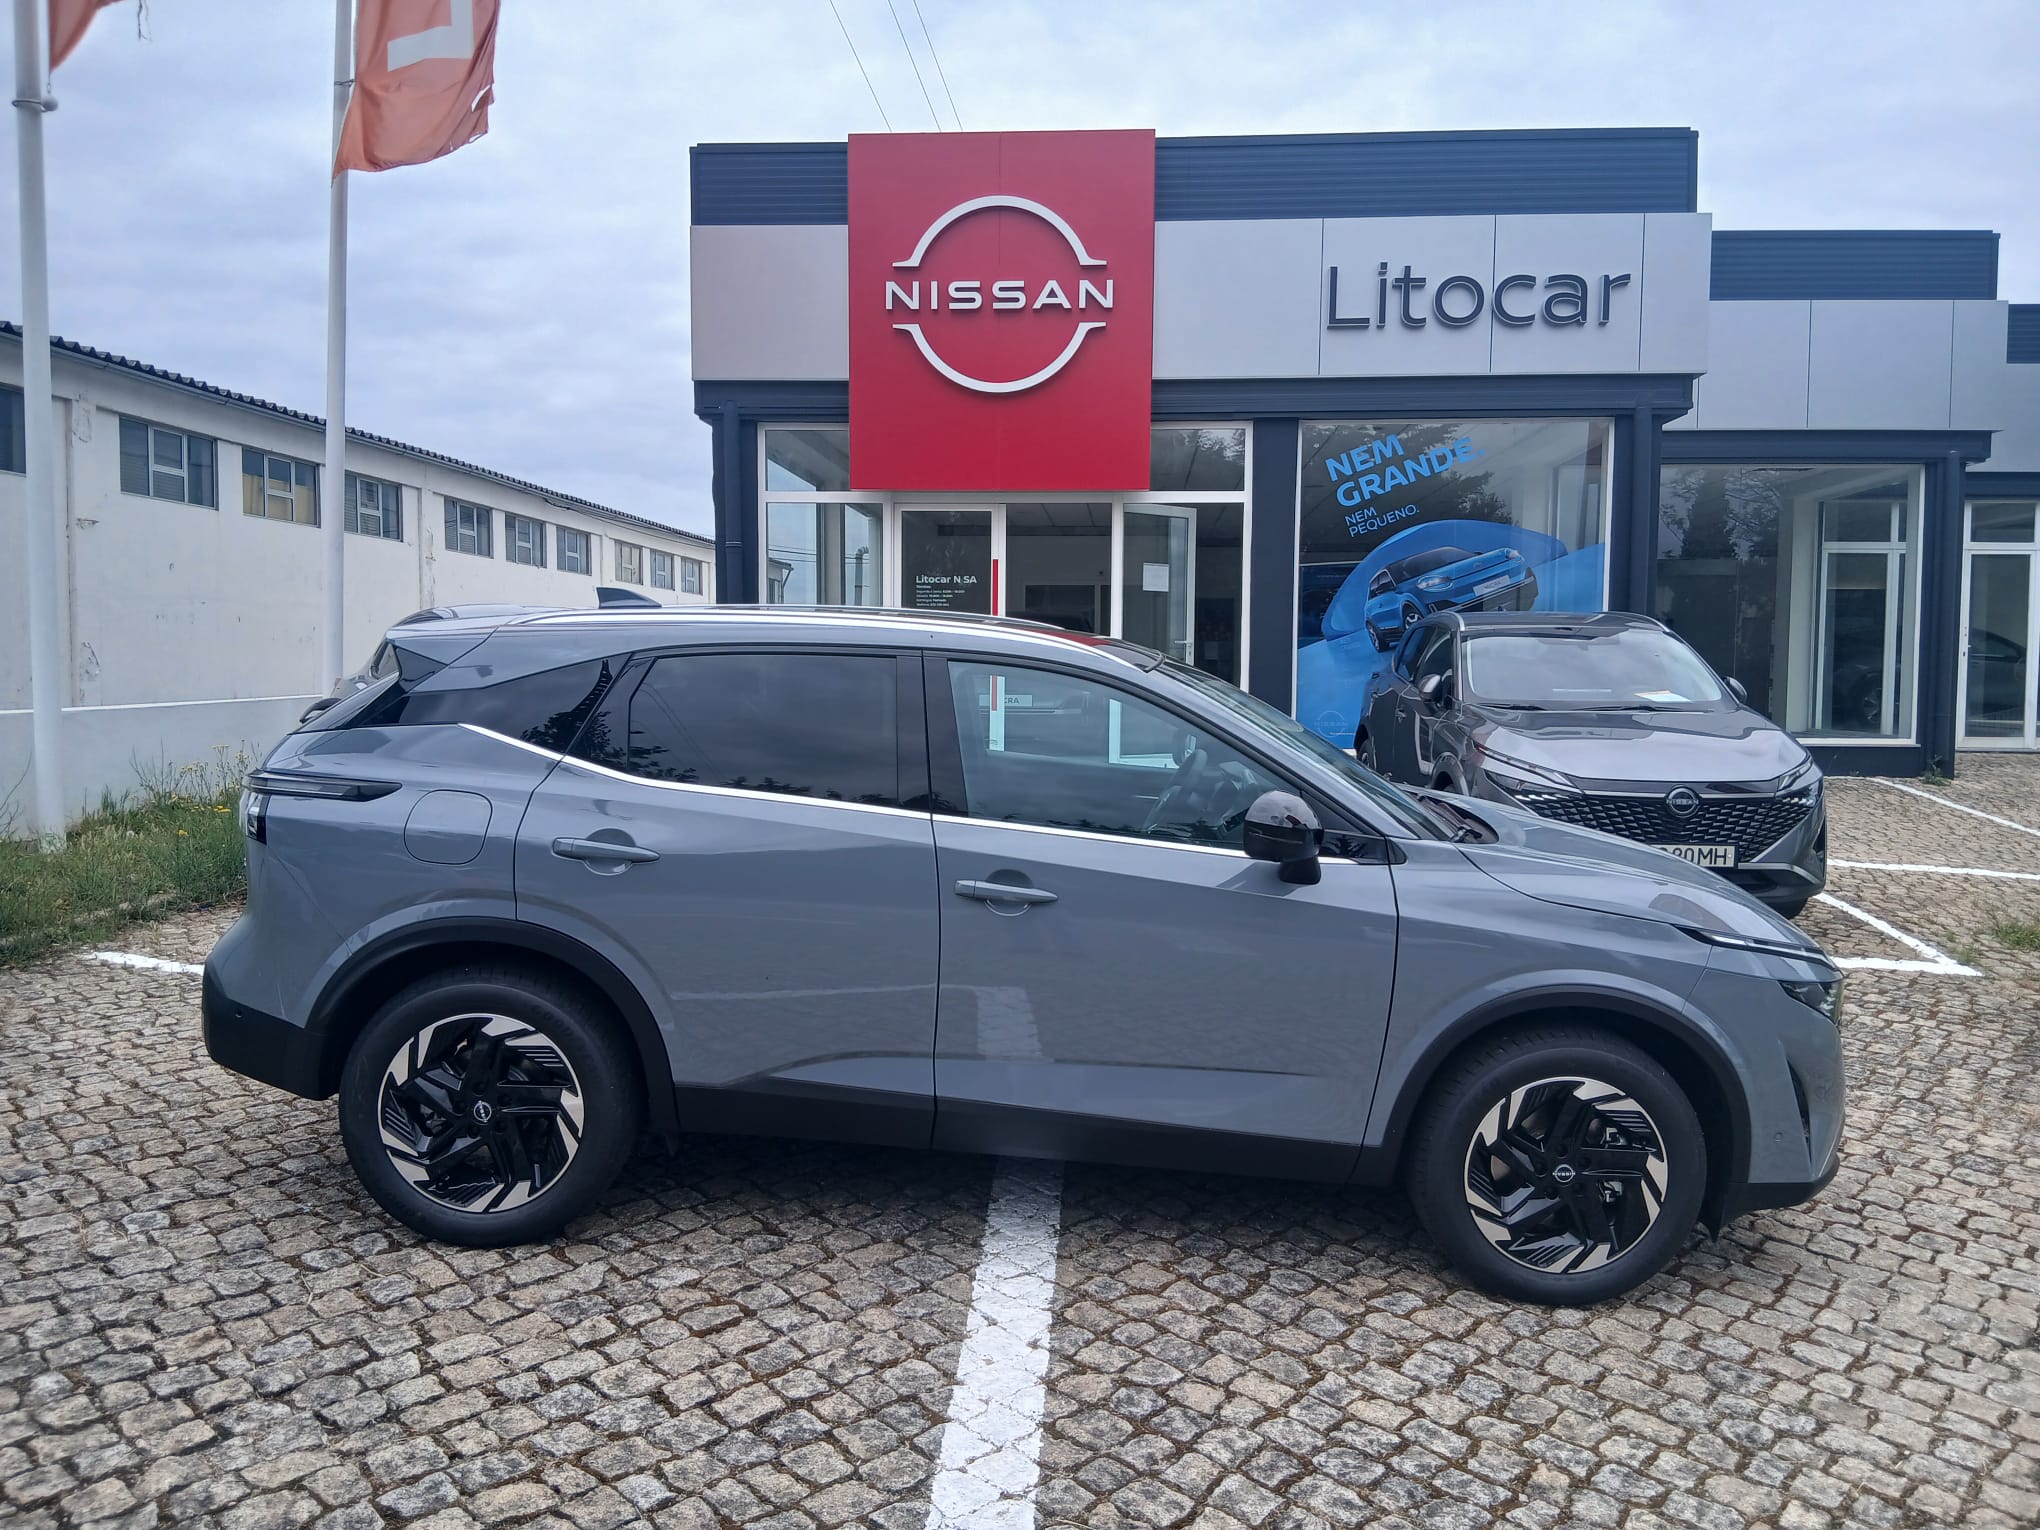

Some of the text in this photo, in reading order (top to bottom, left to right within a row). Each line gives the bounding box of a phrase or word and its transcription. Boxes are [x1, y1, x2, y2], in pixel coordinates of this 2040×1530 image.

[885, 279, 1114, 310] NISSAN
[1327, 261, 1632, 329] Litocar
[1325, 433, 1405, 482] NEM
[1336, 436, 1486, 507] GRANDE.
[1344, 506, 1377, 527] NEM
[1349, 503, 1420, 538] PEQUENO.
[916, 574, 977, 583] Litocar N SA
